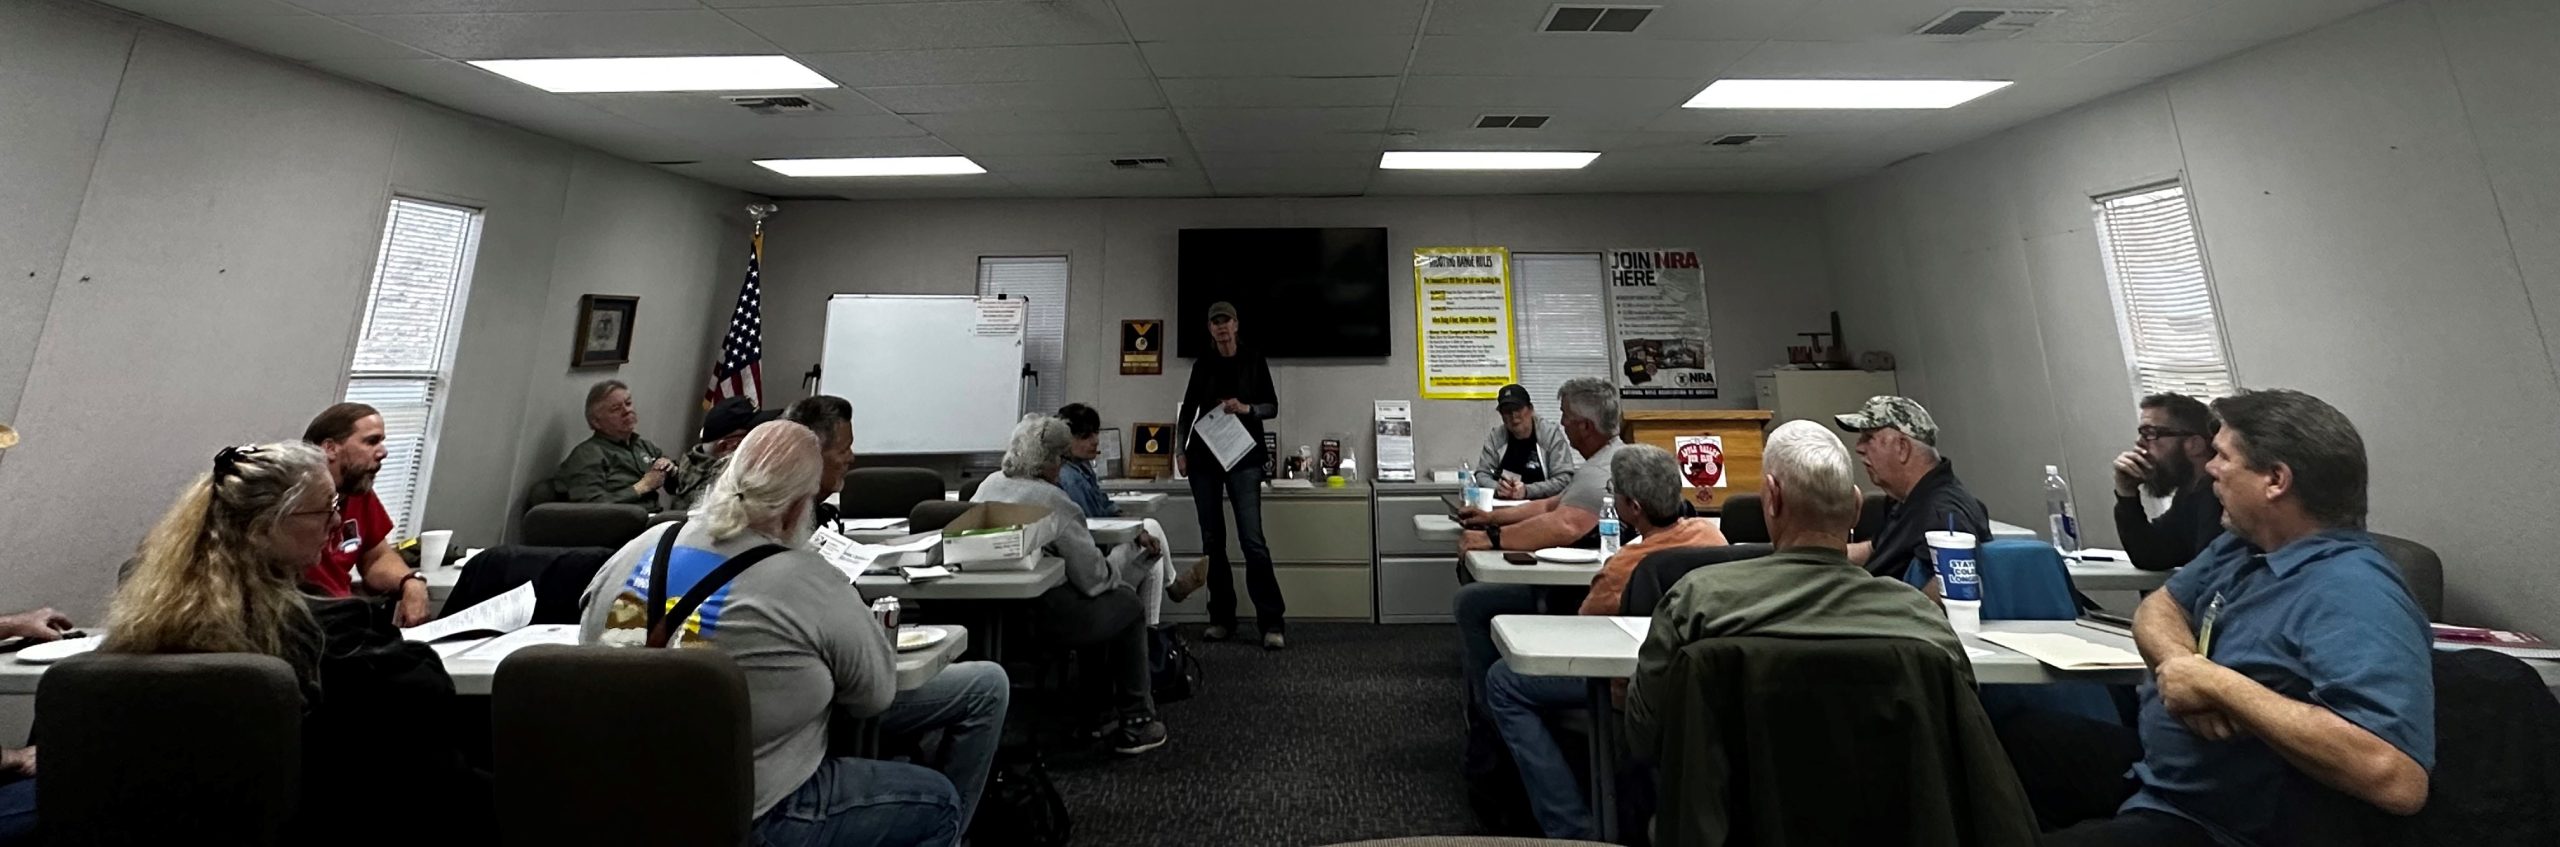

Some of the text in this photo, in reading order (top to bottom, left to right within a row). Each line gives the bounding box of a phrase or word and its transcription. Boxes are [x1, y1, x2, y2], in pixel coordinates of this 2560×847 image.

[1611, 251, 1699, 269] JOIN NRA
[1612, 270, 1656, 286] HERE
[1688, 372, 1714, 383] NRA
